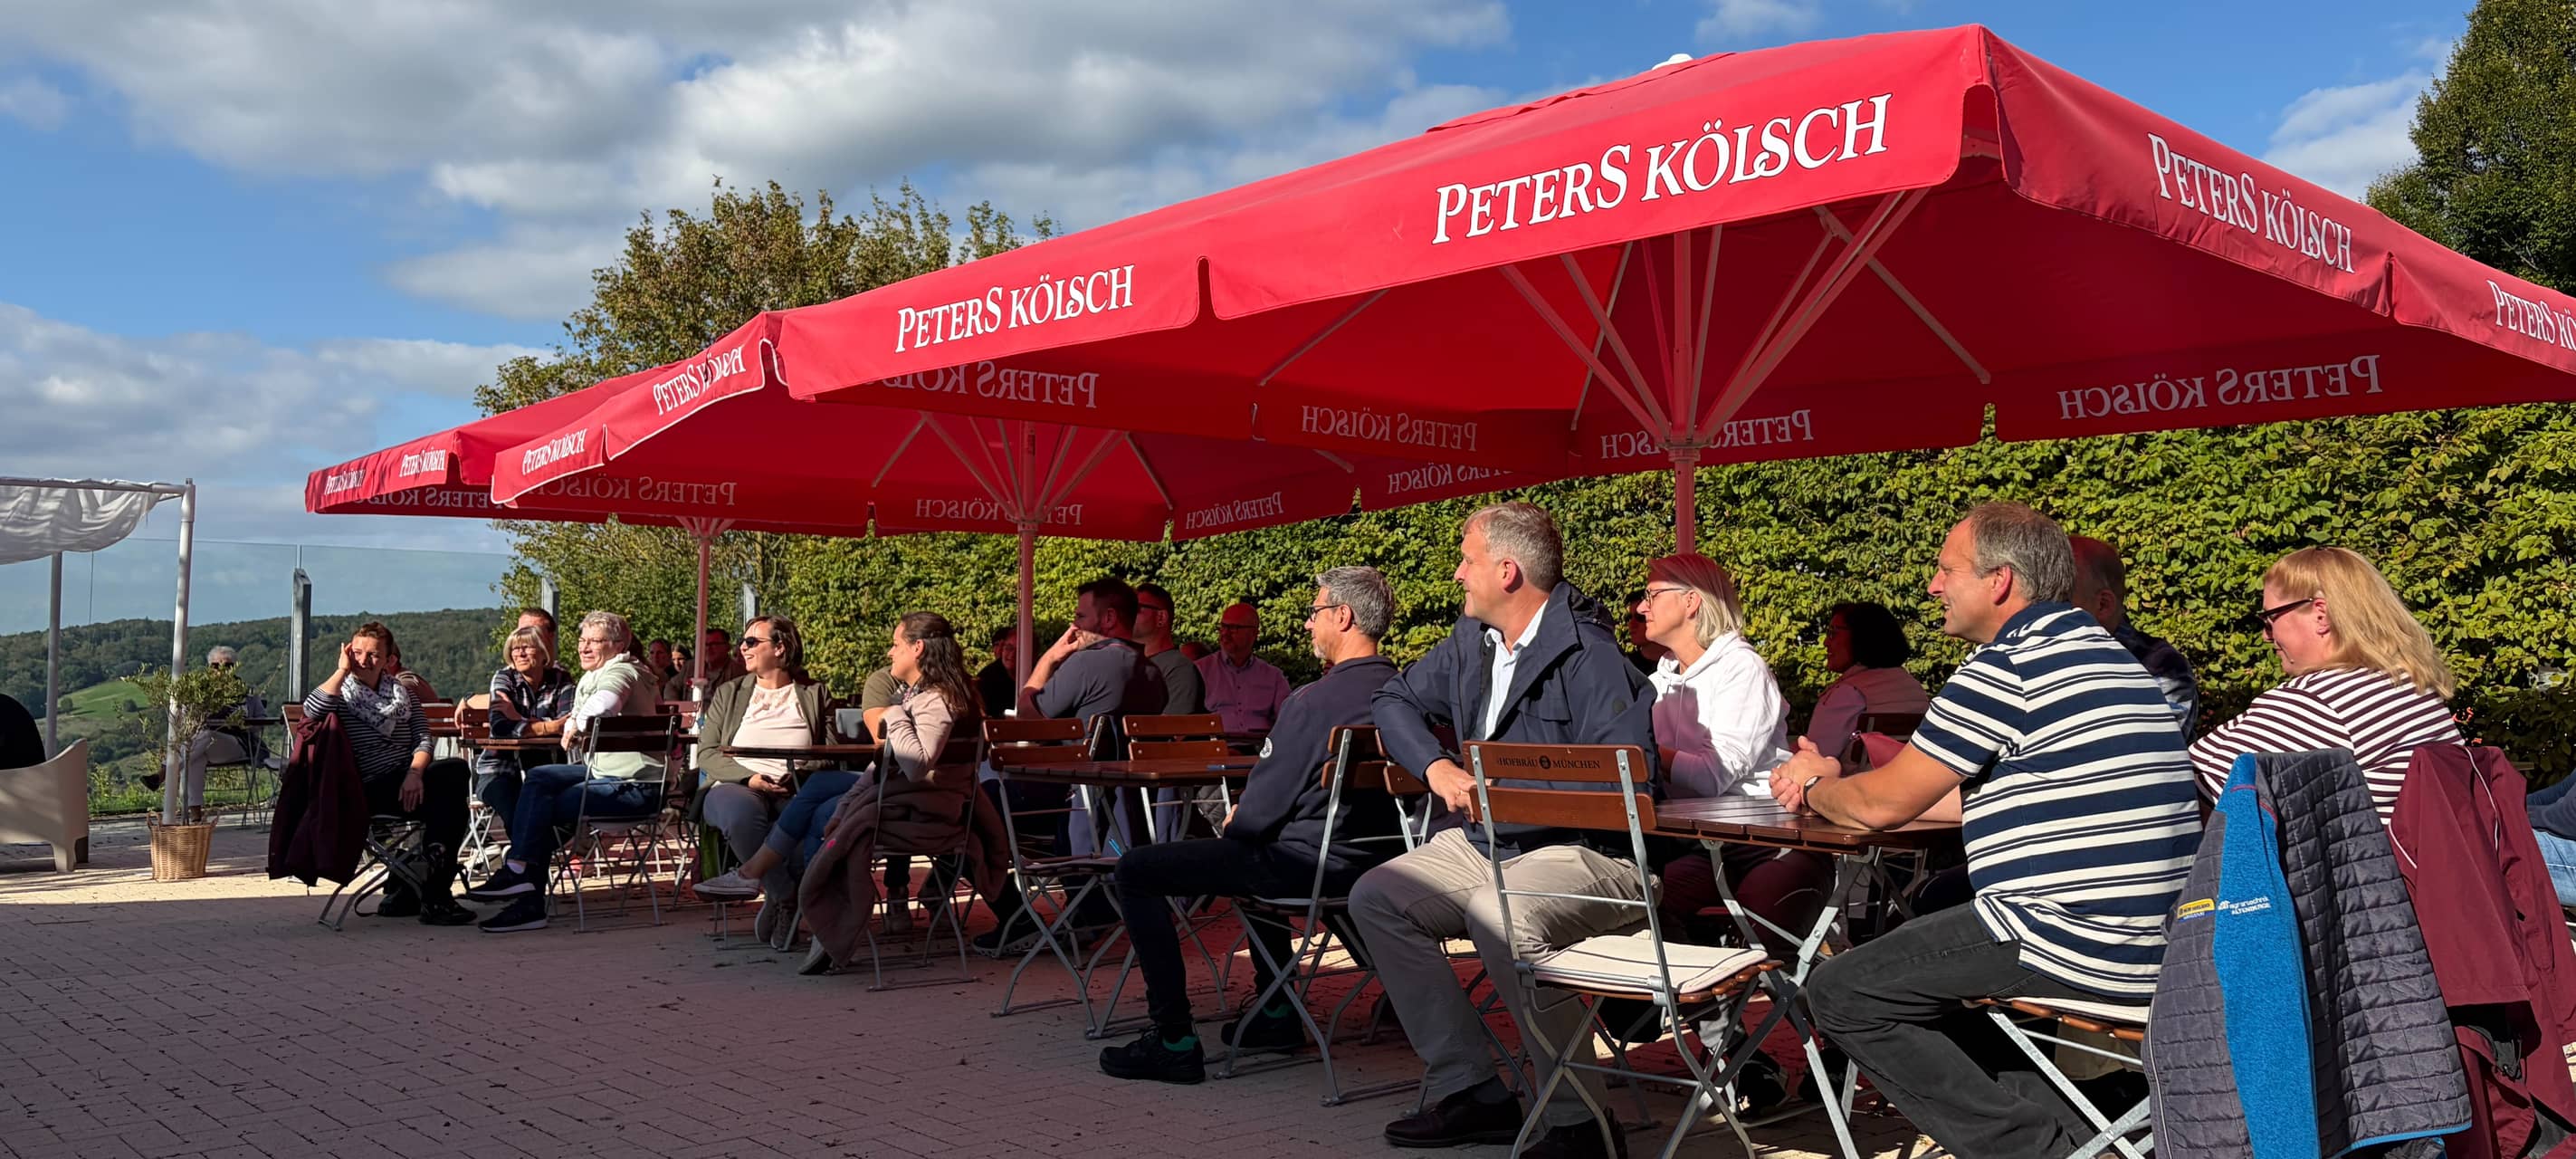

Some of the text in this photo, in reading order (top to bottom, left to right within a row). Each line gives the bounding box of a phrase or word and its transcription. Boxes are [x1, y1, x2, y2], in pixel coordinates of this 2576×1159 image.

[1432, 92, 1893, 244] PETERS KÖLSCH
[2147, 132, 2354, 273] PETERS KÖLSCH
[894, 264, 1134, 354] PETERS KÖLSCH
[2485, 279, 2555, 344] PETERS
[653, 364, 701, 417] PETERS
[522, 439, 556, 476] PETERS
[1552, 757, 1600, 769] MÜNCHEN
